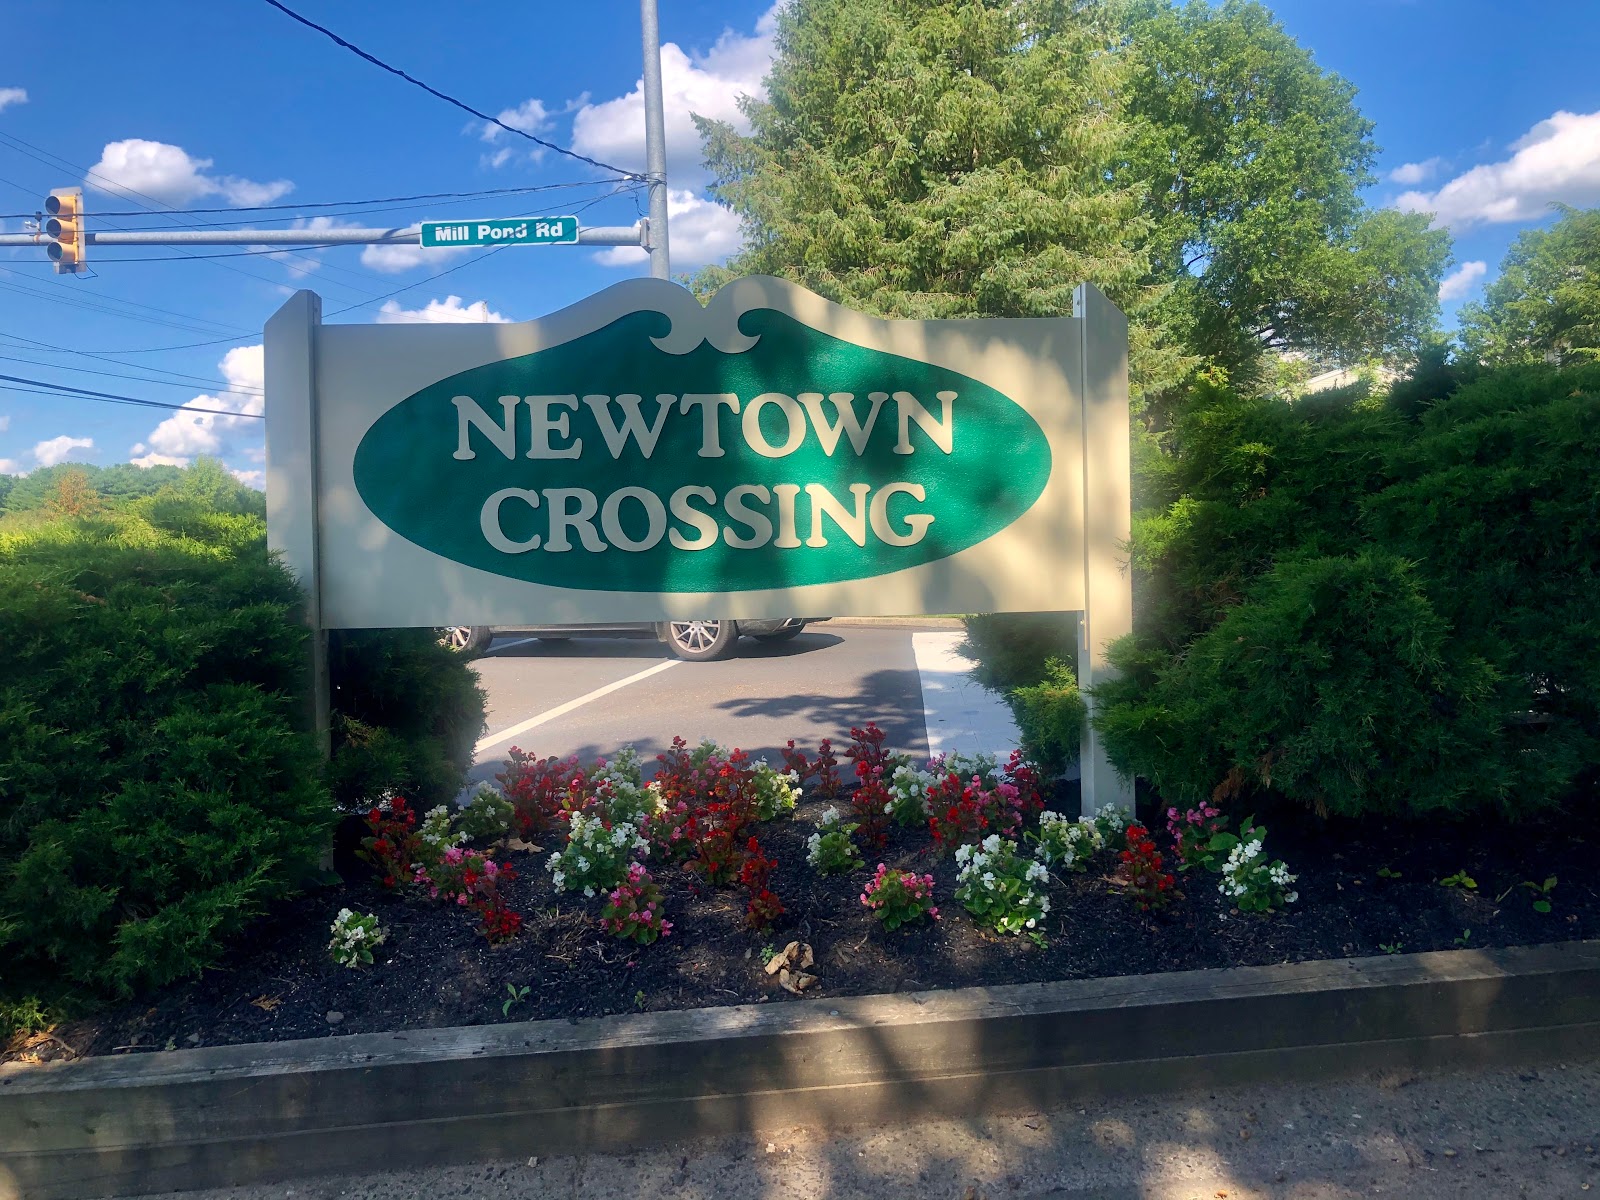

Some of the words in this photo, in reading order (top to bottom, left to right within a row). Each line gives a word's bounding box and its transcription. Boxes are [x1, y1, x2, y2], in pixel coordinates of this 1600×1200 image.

[435, 225, 469, 241] Mill
[477, 223, 527, 240] Pond
[536, 222, 563, 238] Rd
[451, 390, 958, 461] NEWTOWN
[480, 482, 935, 553] CROSSING
